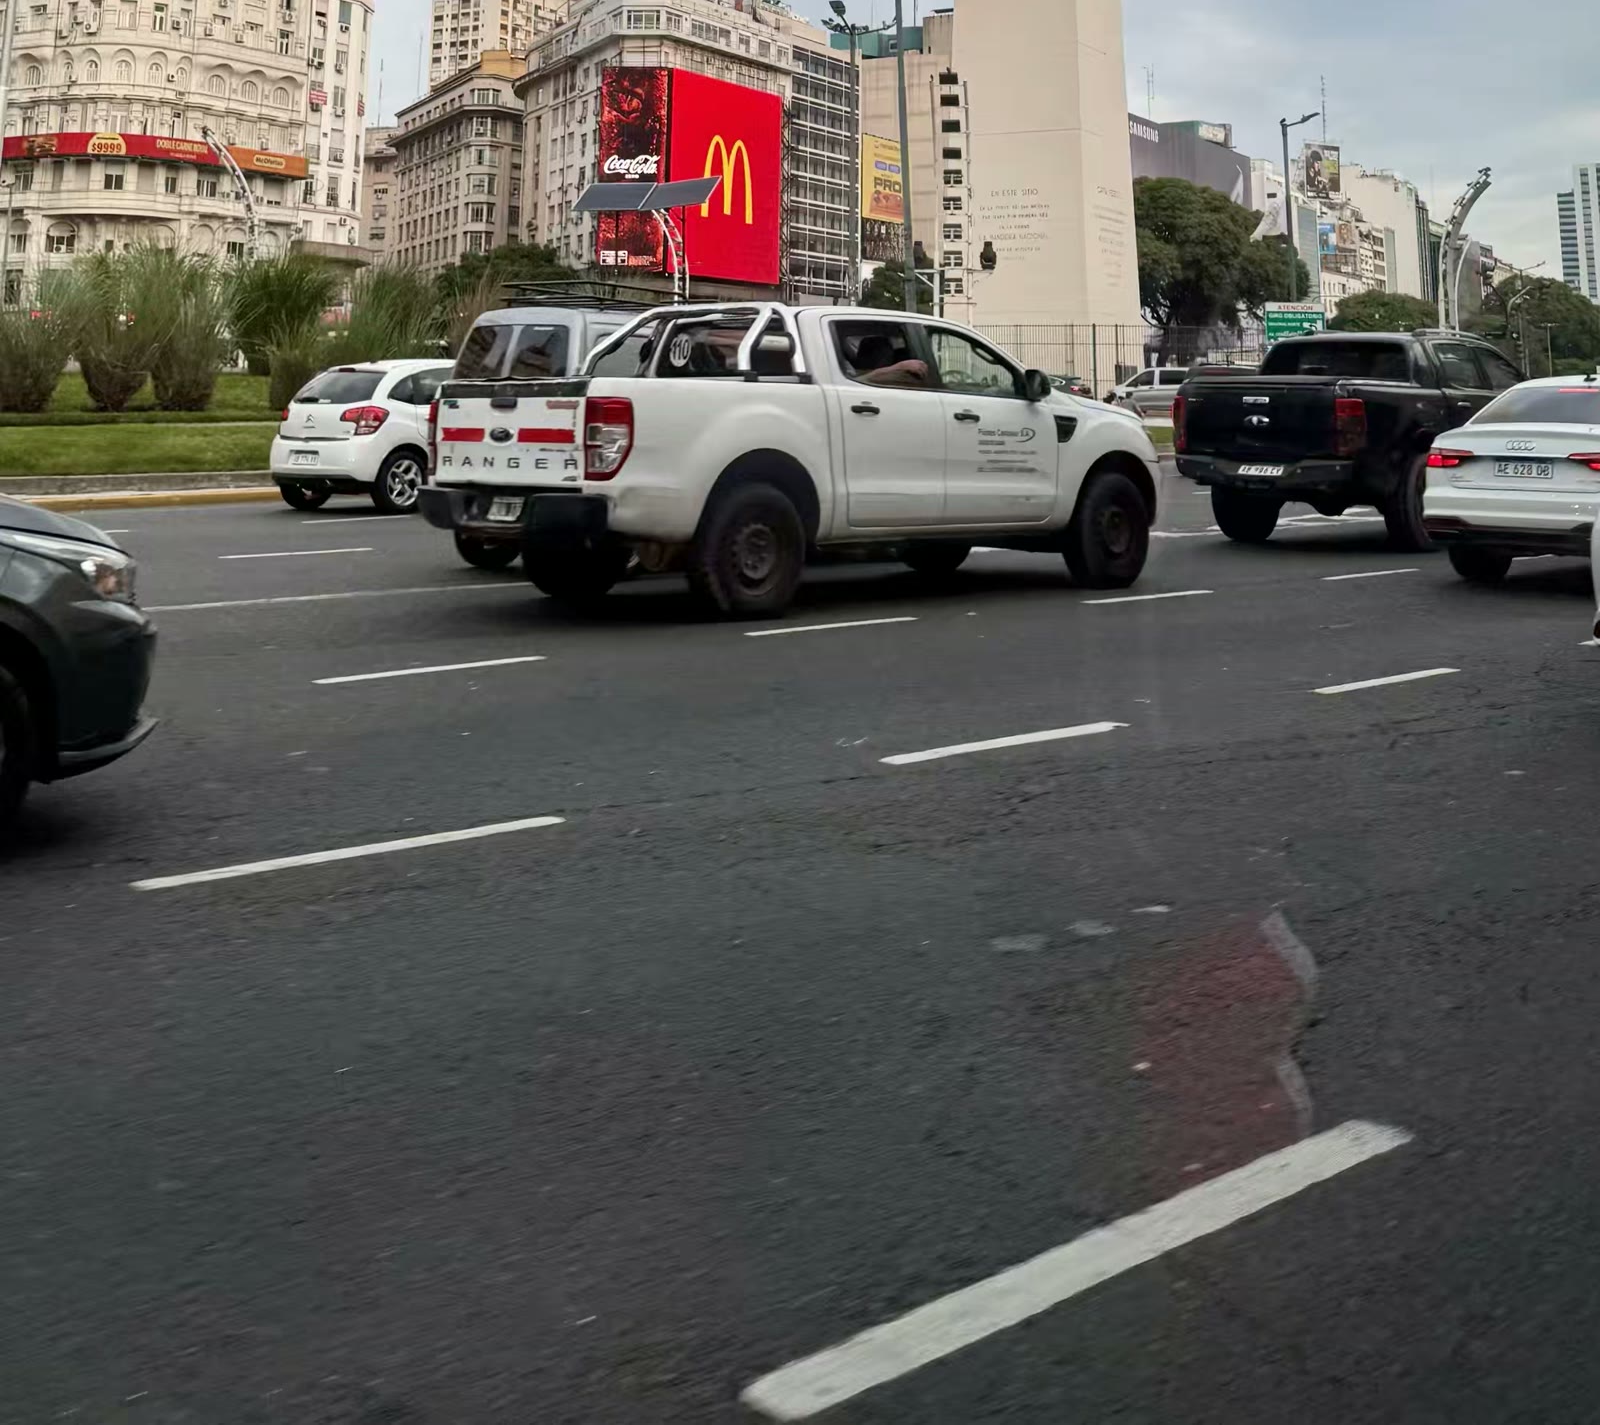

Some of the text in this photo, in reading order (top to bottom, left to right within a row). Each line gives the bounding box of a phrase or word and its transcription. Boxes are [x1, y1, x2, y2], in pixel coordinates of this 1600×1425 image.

[1129, 120, 1159, 143] SAMSUNG
[91, 142, 122, 153] $9999
[604, 154, 661, 174] Coca-Cola
[1002, 189, 1017, 197] ESTE
[1020, 188, 1039, 196] SITIO
[672, 338, 689, 361] 110
[442, 456, 578, 470] RANGER
[1497, 463, 1510, 475] AE
[1512, 464, 1533, 476] 628
